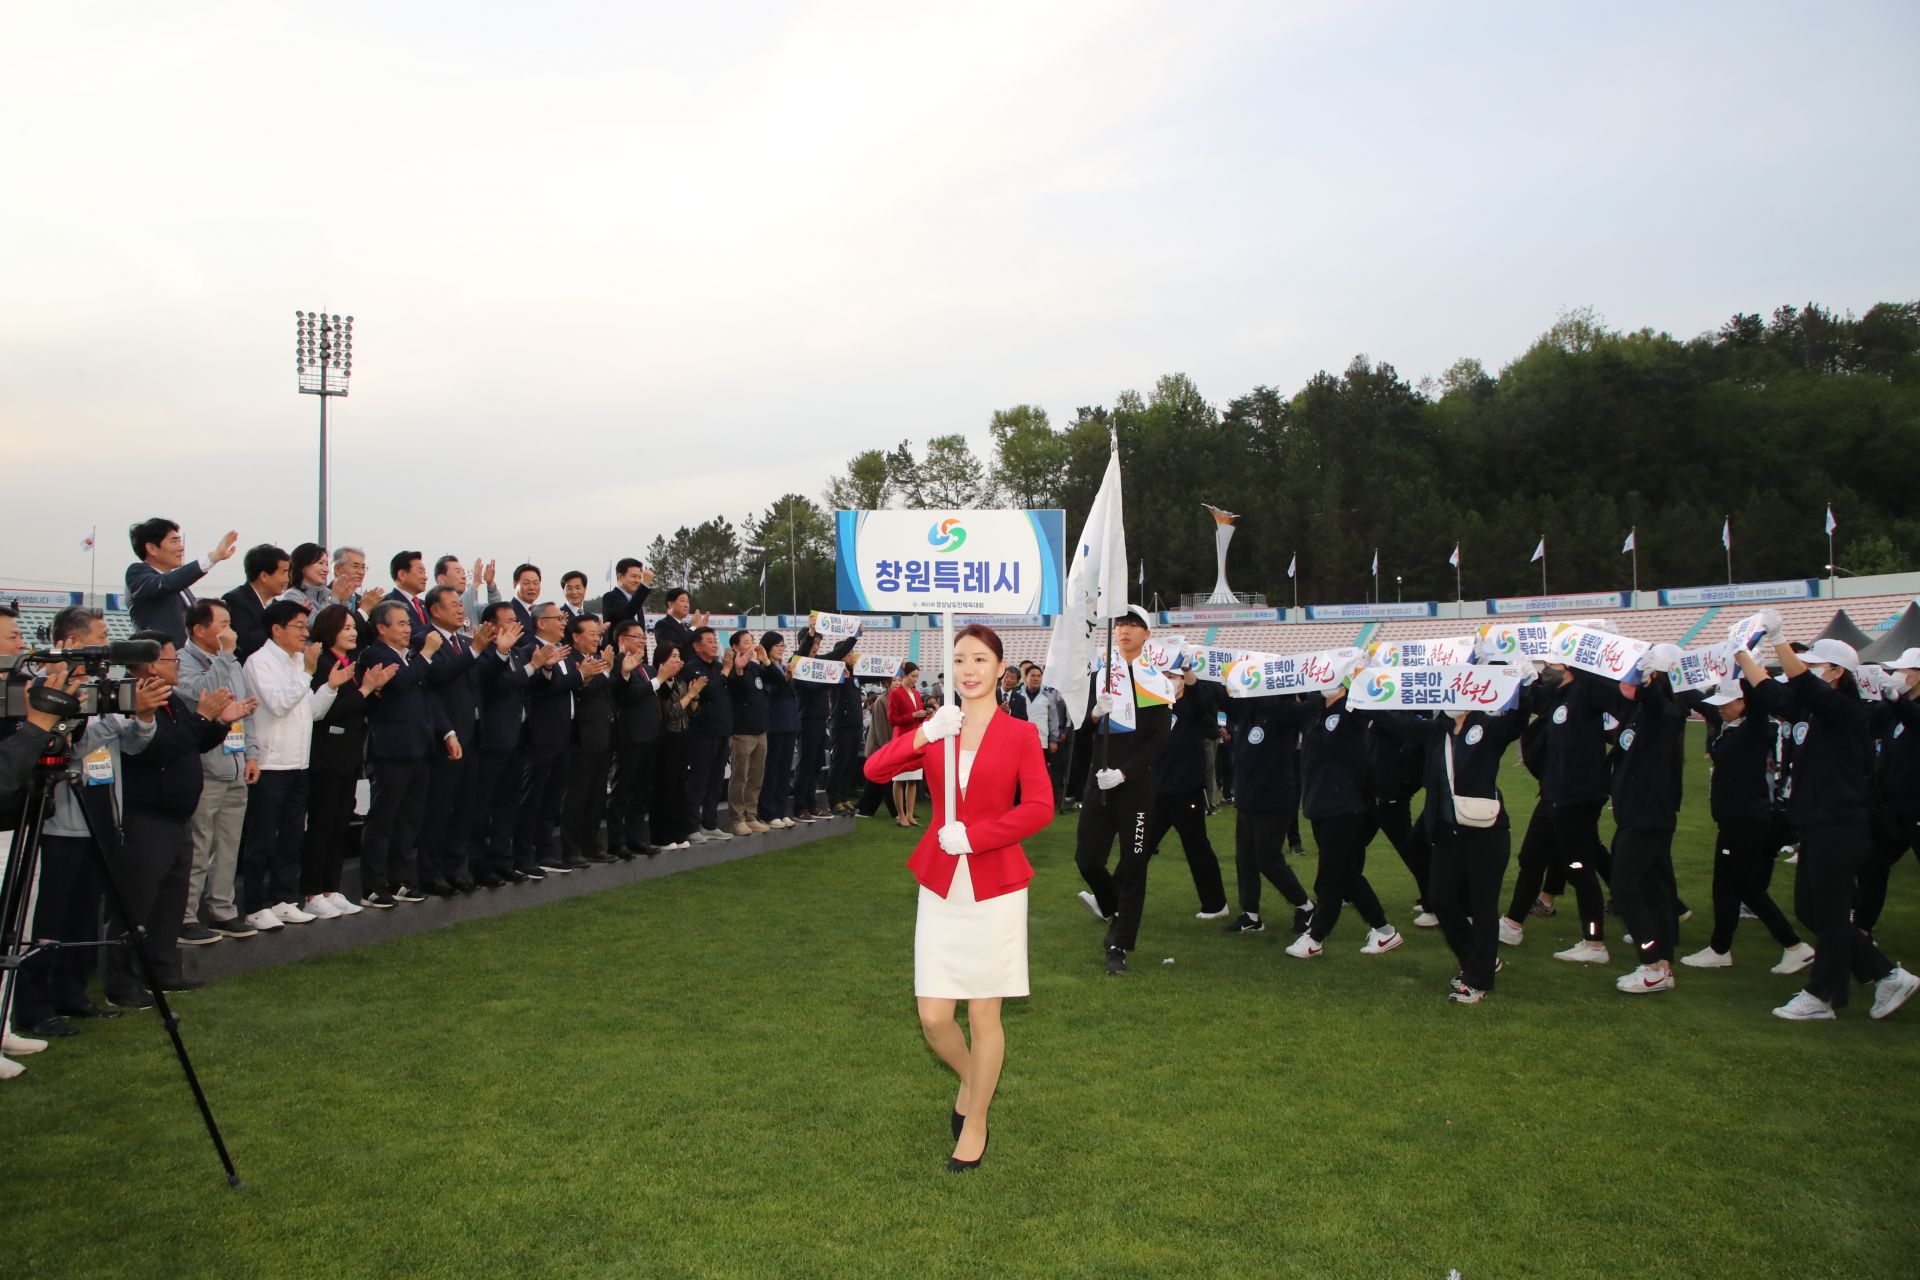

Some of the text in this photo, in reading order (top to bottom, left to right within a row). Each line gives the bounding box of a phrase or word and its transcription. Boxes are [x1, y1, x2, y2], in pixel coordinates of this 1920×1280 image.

[875, 560, 1020, 594] 창원특례시
[1518, 626, 1547, 641] 동북아
[1579, 633, 1604, 650] 동북아
[1209, 650, 1233, 663] 동북아
[1402, 644, 1426, 657] 동북아
[1519, 641, 1552, 655] 중심도
[1601, 640, 1624, 673] 창원
[1574, 647, 1604, 668] 중심도시
[1264, 659, 1295, 676] 동북아
[1299, 656, 1336, 684] 창원
[1265, 673, 1305, 690] 중심도시
[1400, 671, 1443, 687] 동북아
[1450, 671, 1498, 704] 창원
[1400, 688, 1456, 705] 중심도시
[1133, 812, 1145, 854] HAZZYS
